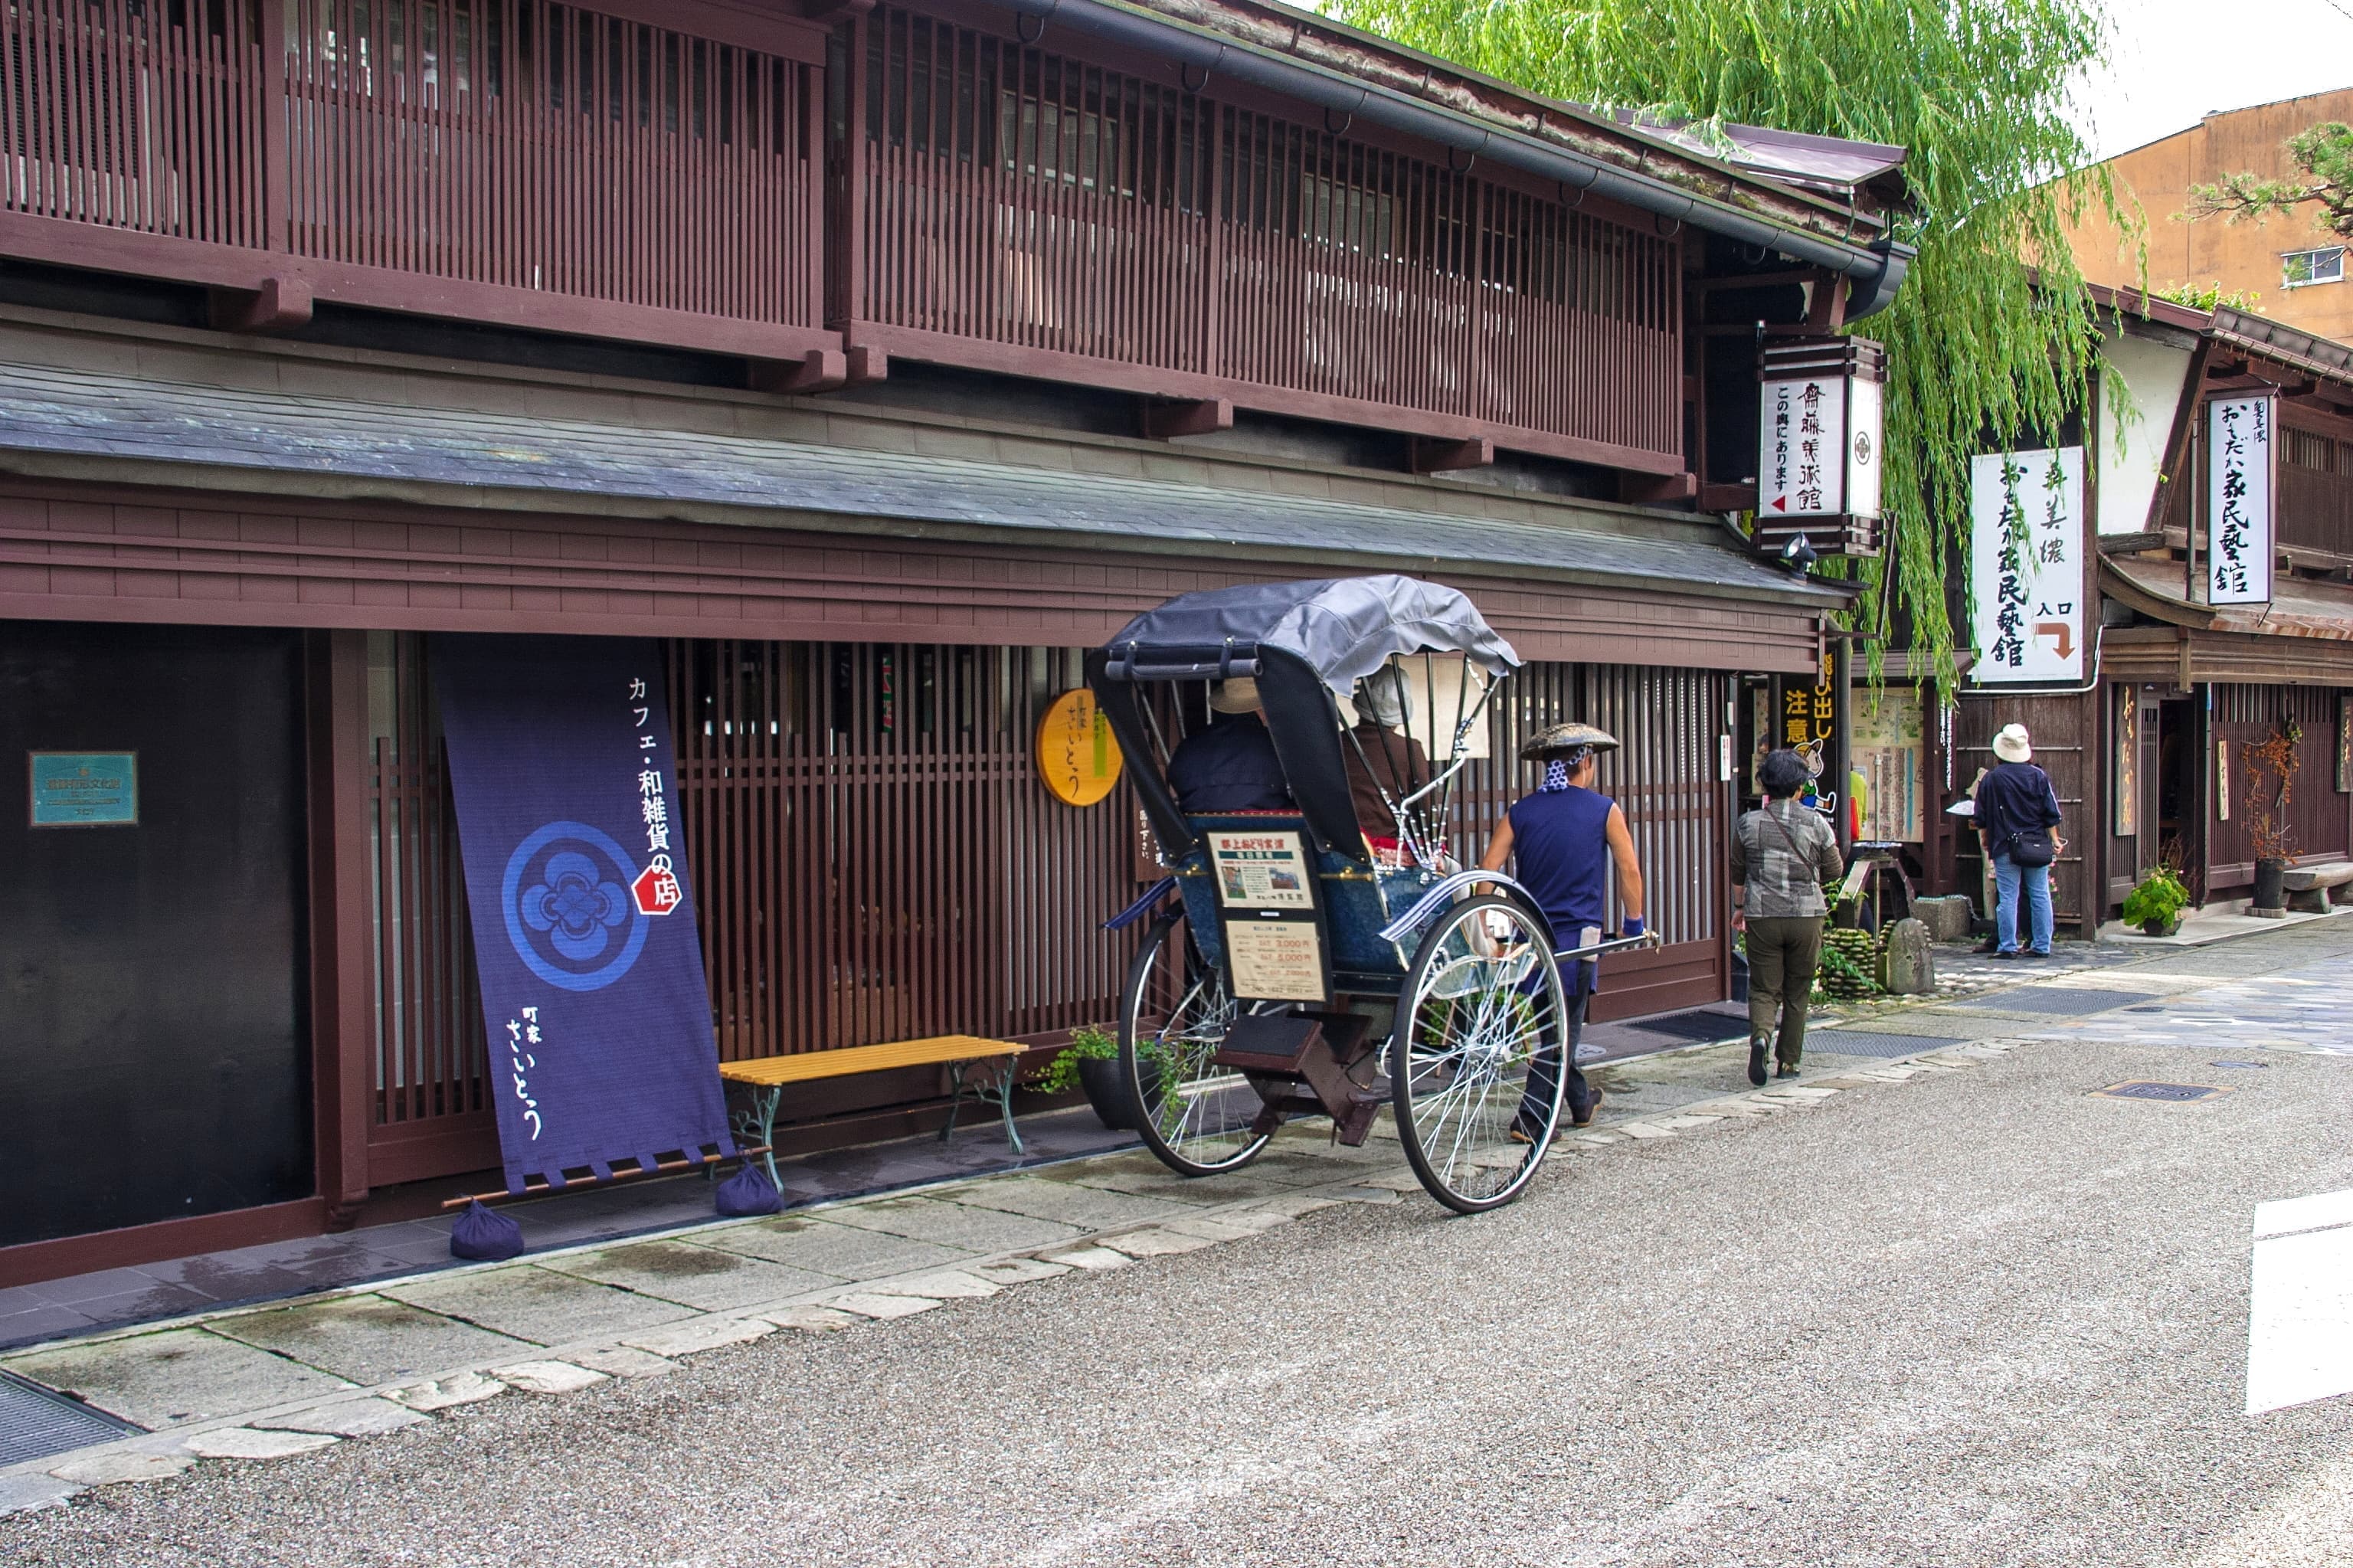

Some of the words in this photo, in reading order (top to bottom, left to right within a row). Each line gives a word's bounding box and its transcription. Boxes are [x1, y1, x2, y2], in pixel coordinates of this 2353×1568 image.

[1774, 386, 1789, 493] この奥にあります
[2036, 602, 2073, 617] 入口
[1785, 689, 1808, 744] 注意
[629, 677, 677, 907] カフェ・和雑貨の店
[506, 1019, 542, 1141] さいとう
